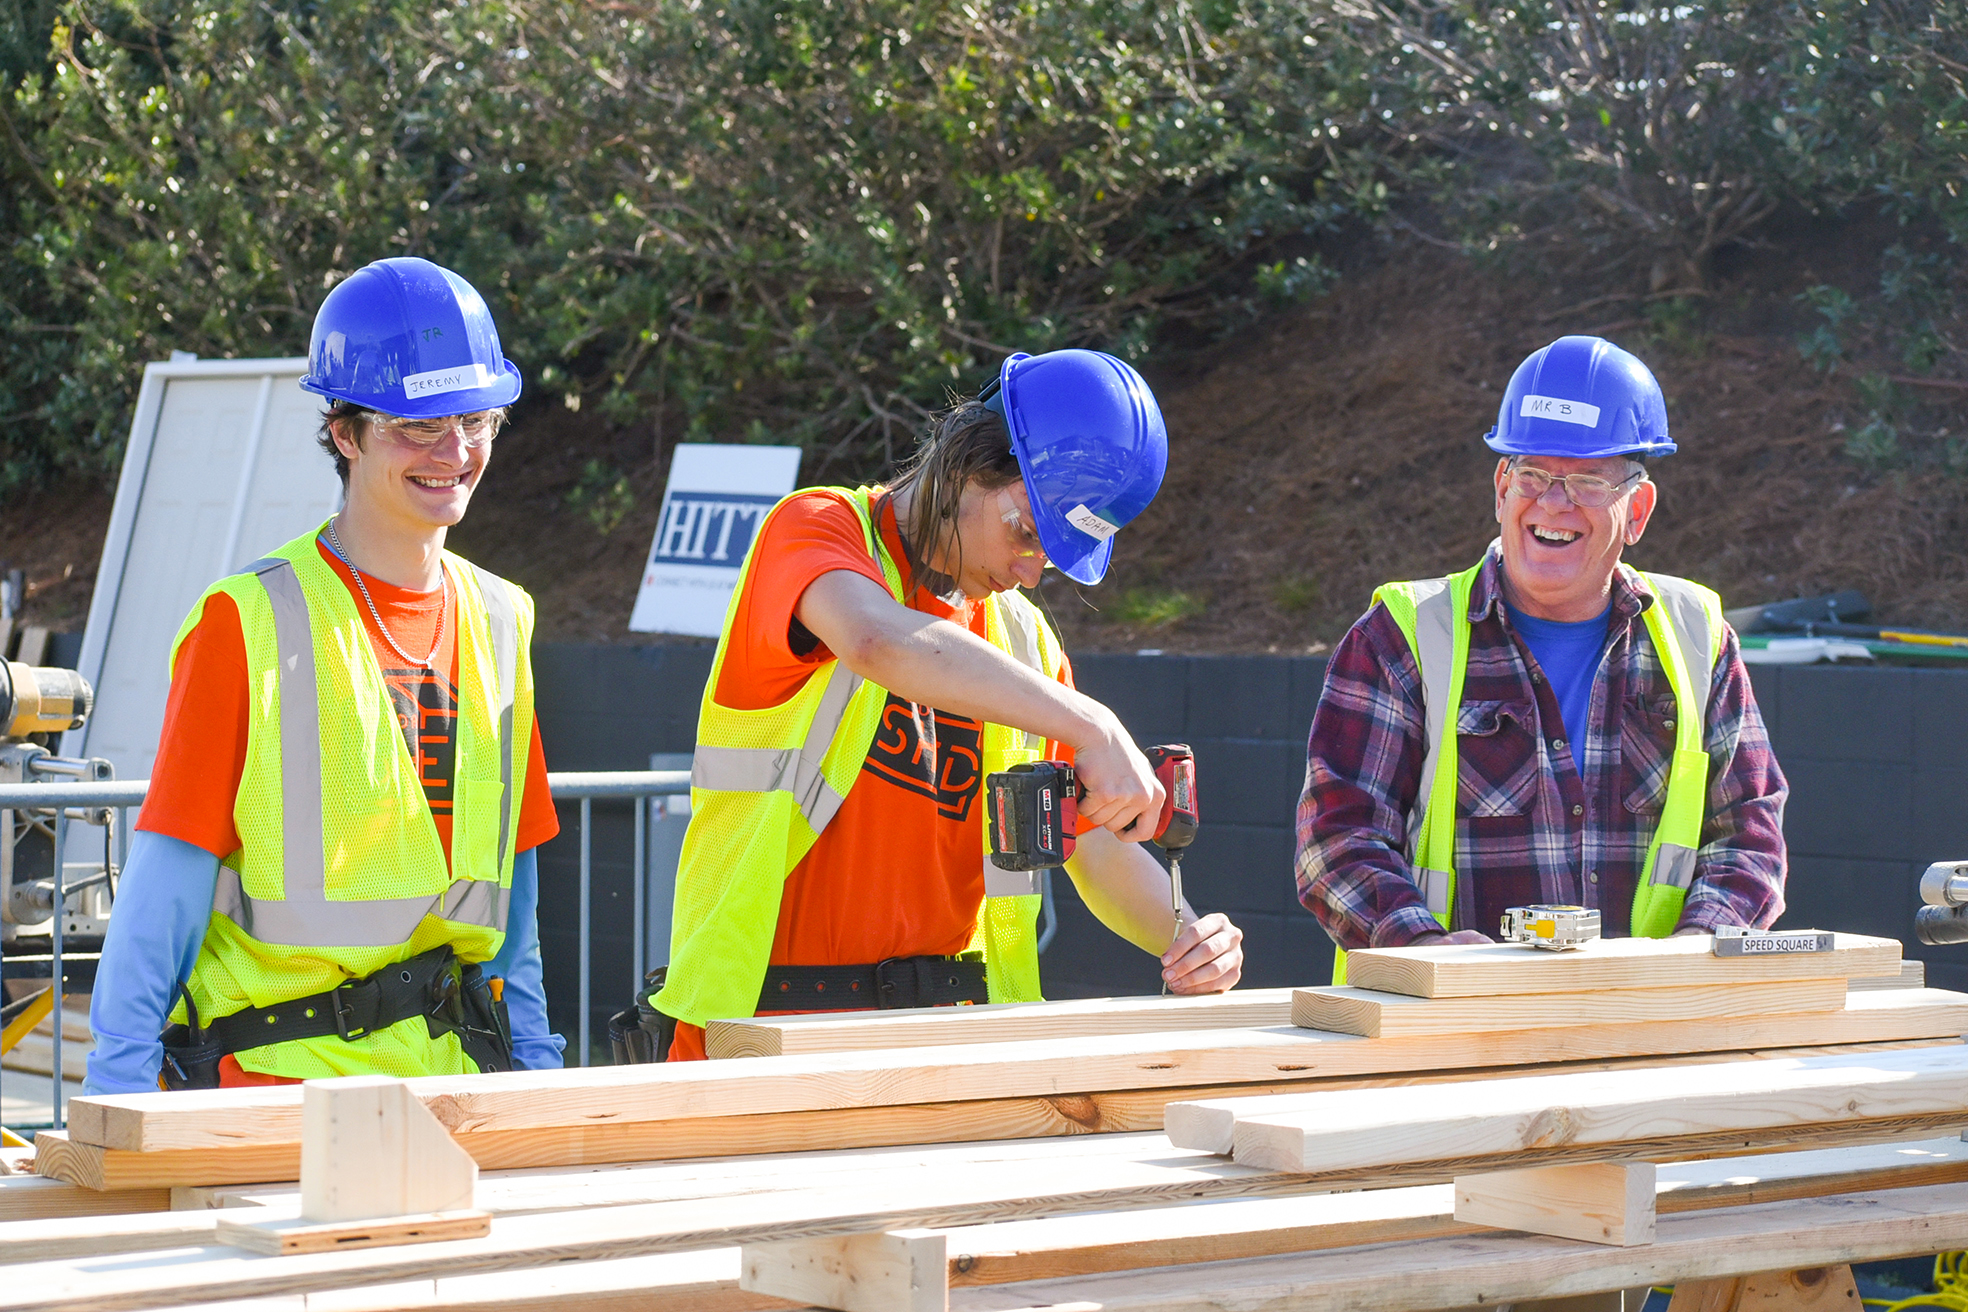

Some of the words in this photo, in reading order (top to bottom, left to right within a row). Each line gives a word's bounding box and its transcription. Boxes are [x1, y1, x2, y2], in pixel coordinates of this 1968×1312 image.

[421, 326, 443, 342] JR
[410, 374, 461, 393] JEREMY
[1530, 399, 1553, 413] MR
[1559, 403, 1573, 415] B
[1076, 515, 1110, 535] ADAM
[1744, 939, 1774, 951] SPEED
[1776, 938, 1814, 952] SQUARE
